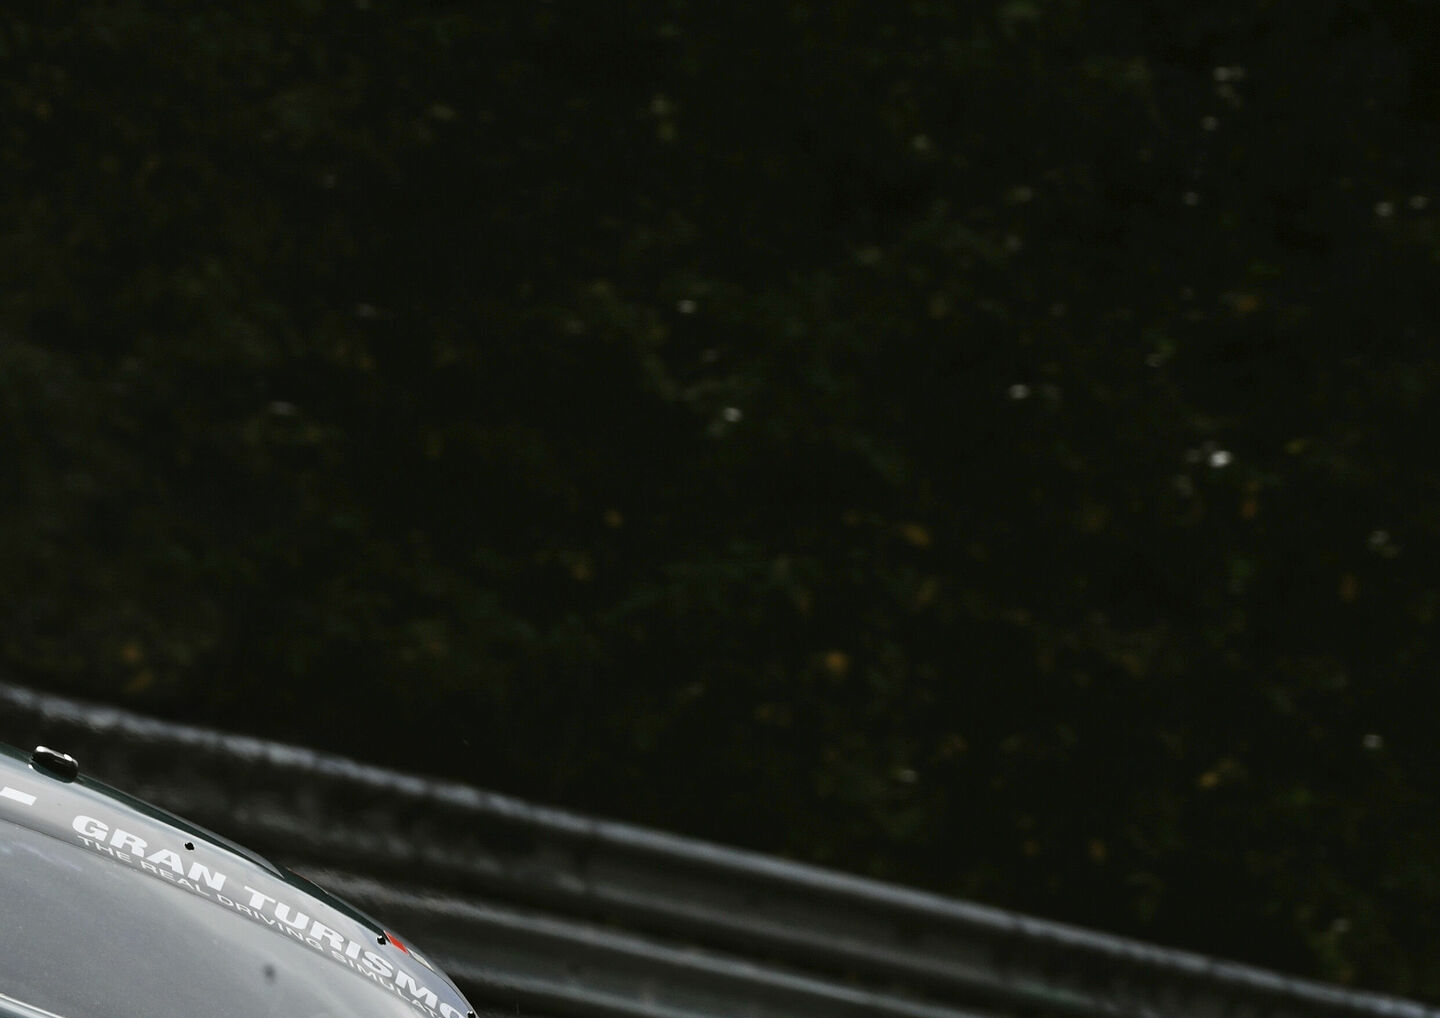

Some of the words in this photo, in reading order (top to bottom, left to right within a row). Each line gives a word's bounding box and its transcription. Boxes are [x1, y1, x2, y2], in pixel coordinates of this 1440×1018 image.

[72, 815, 227, 892] GRAN
[77, 835, 133, 864] THE
[140, 860, 211, 897] REAL
[216, 893, 324, 951] DRIVING
